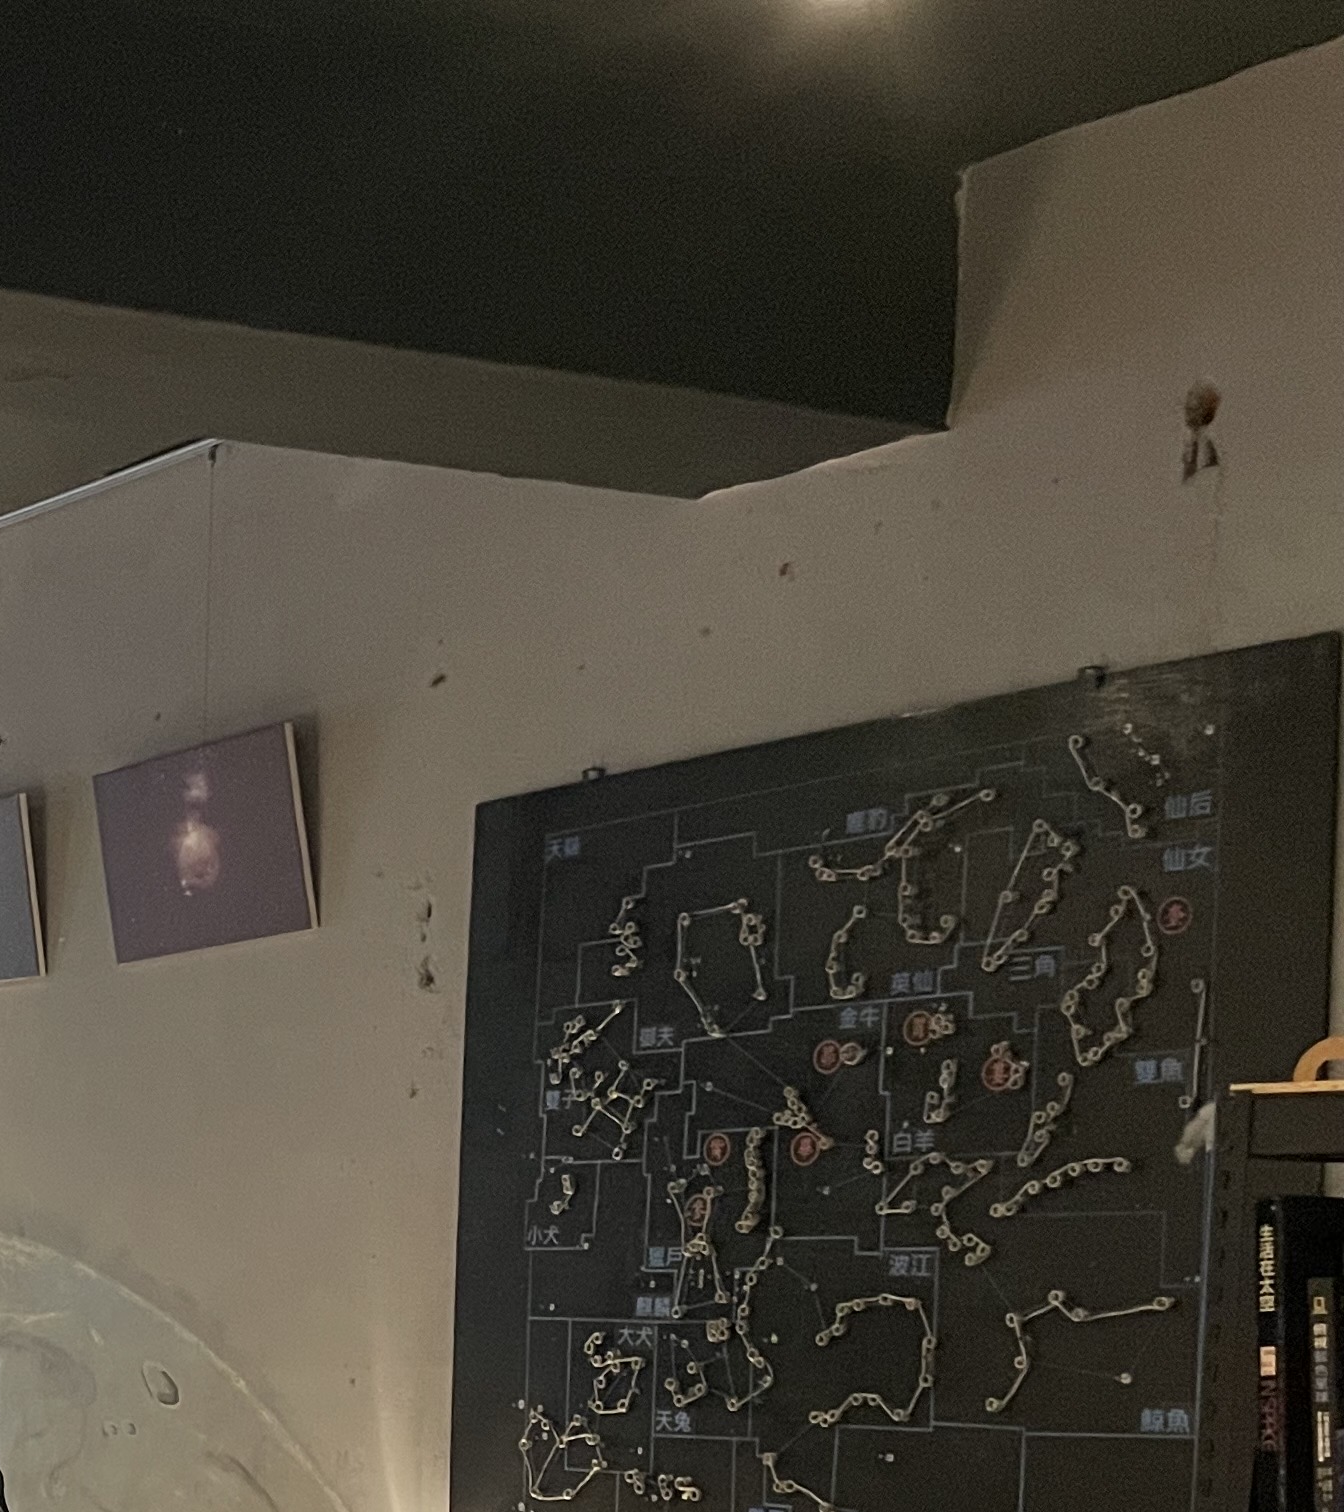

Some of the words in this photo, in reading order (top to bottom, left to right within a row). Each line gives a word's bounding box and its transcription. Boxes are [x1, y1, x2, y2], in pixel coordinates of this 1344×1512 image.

[1164, 793, 1214, 820] 仙后
[1162, 846, 1214, 872] 仙女
[1008, 956, 1058, 982] 三角
[890, 972, 936, 994] 英仙
[839, 1011, 881, 1030] 金牛
[892, 1131, 936, 1154] 白羊
[527, 1228, 560, 1246] 小犬
[889, 1257, 933, 1277] 波江
[618, 1328, 654, 1346] 大犬
[655, 1411, 692, 1432] 天兔
[1141, 1411, 1191, 1434] 鯨魚
